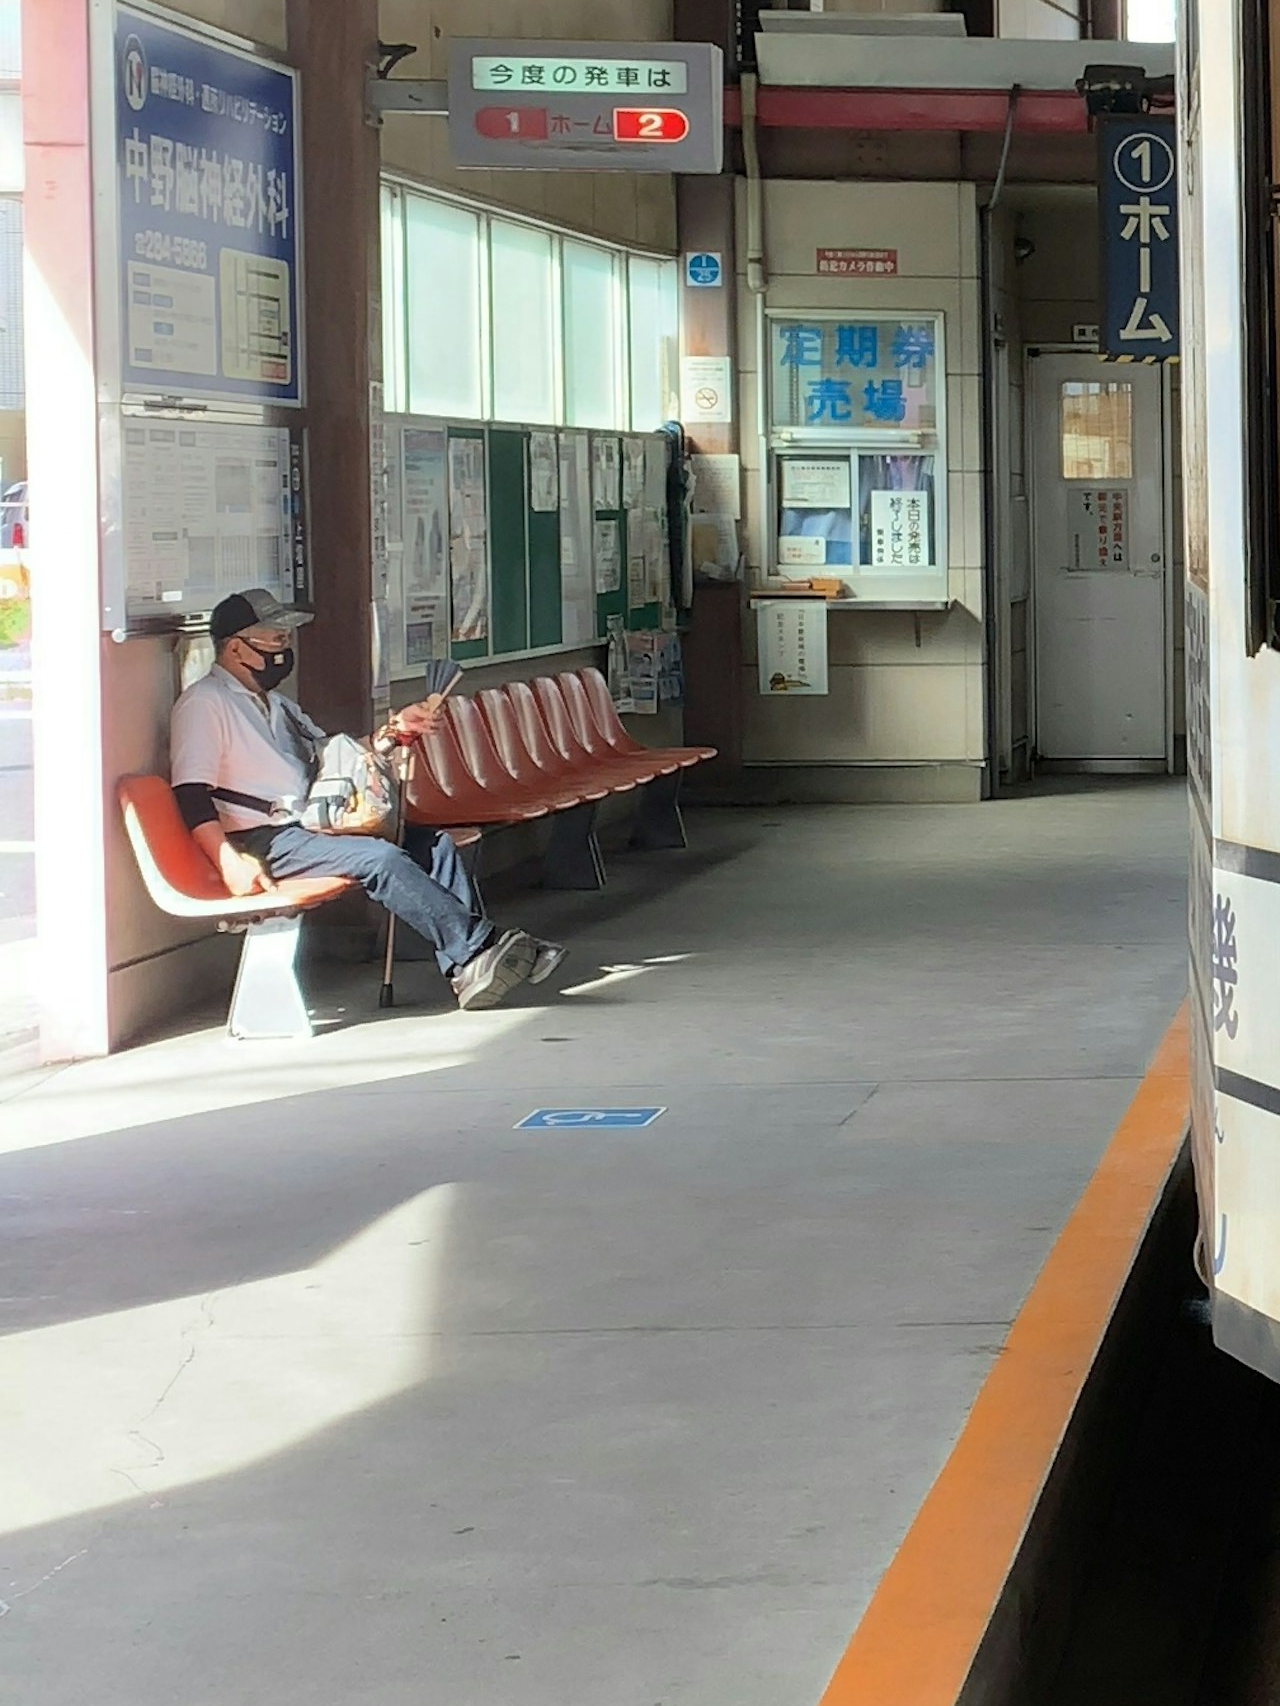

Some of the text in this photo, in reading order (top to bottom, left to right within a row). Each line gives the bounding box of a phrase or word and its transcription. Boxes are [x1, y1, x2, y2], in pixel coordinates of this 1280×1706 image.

[490, 64, 672, 88] 今度の発車は
[505, 111, 664, 137] 1 ホーム 2
[780, 324, 934, 368] 定期券
[807, 378, 907, 421] 売場
